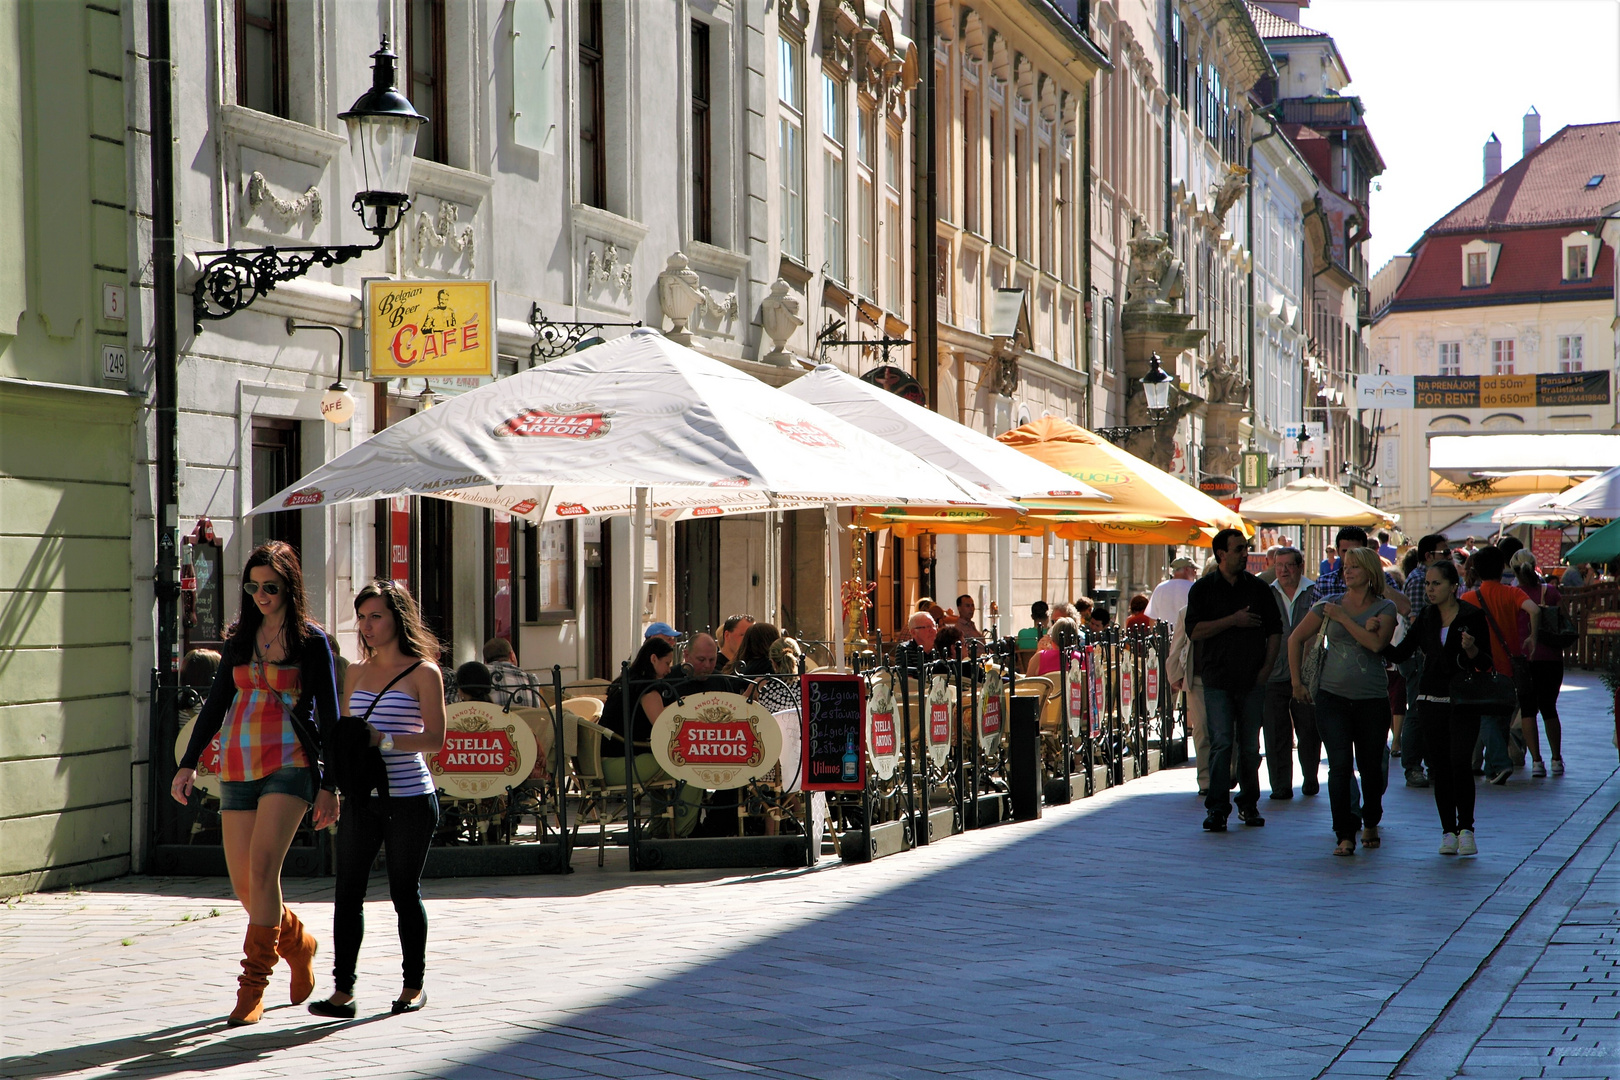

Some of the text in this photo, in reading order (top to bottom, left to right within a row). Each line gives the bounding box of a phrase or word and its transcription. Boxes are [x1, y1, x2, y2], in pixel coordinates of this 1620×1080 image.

[111, 291, 118, 312] 5
[378, 287, 423, 317] Belgian
[388, 303, 421, 329] Beer
[388, 312, 480, 368] CAFÉ
[1417, 379, 1476, 391] NA PRENÁJOM
[1483, 379, 1497, 389] od
[1541, 386, 1585, 394] Bratislava
[1417, 392, 1476, 405] FOR RENT
[1483, 394, 1497, 404] do
[320, 399, 343, 415] CAFÉ
[522, 415, 594, 426] STELLA
[514, 424, 591, 435] ARTOIS
[1200, 483, 1215, 491] FOOD
[948, 511, 986, 519] RAUCH
[392, 544, 408, 563] STELLA
[495, 547, 509, 564] STELLA
[694, 700, 711, 711] ANNO
[933, 711, 947, 722] STELLA
[875, 720, 892, 732] STELLA
[934, 724, 947, 736] ARTOIS
[688, 729, 747, 741] STELLA
[875, 734, 893, 747] ARTOIS
[446, 738, 503, 751] STELLA
[688, 744, 748, 756] ARTOIS
[446, 752, 504, 766] ARTOIS
[813, 760, 840, 776] Vilmos
